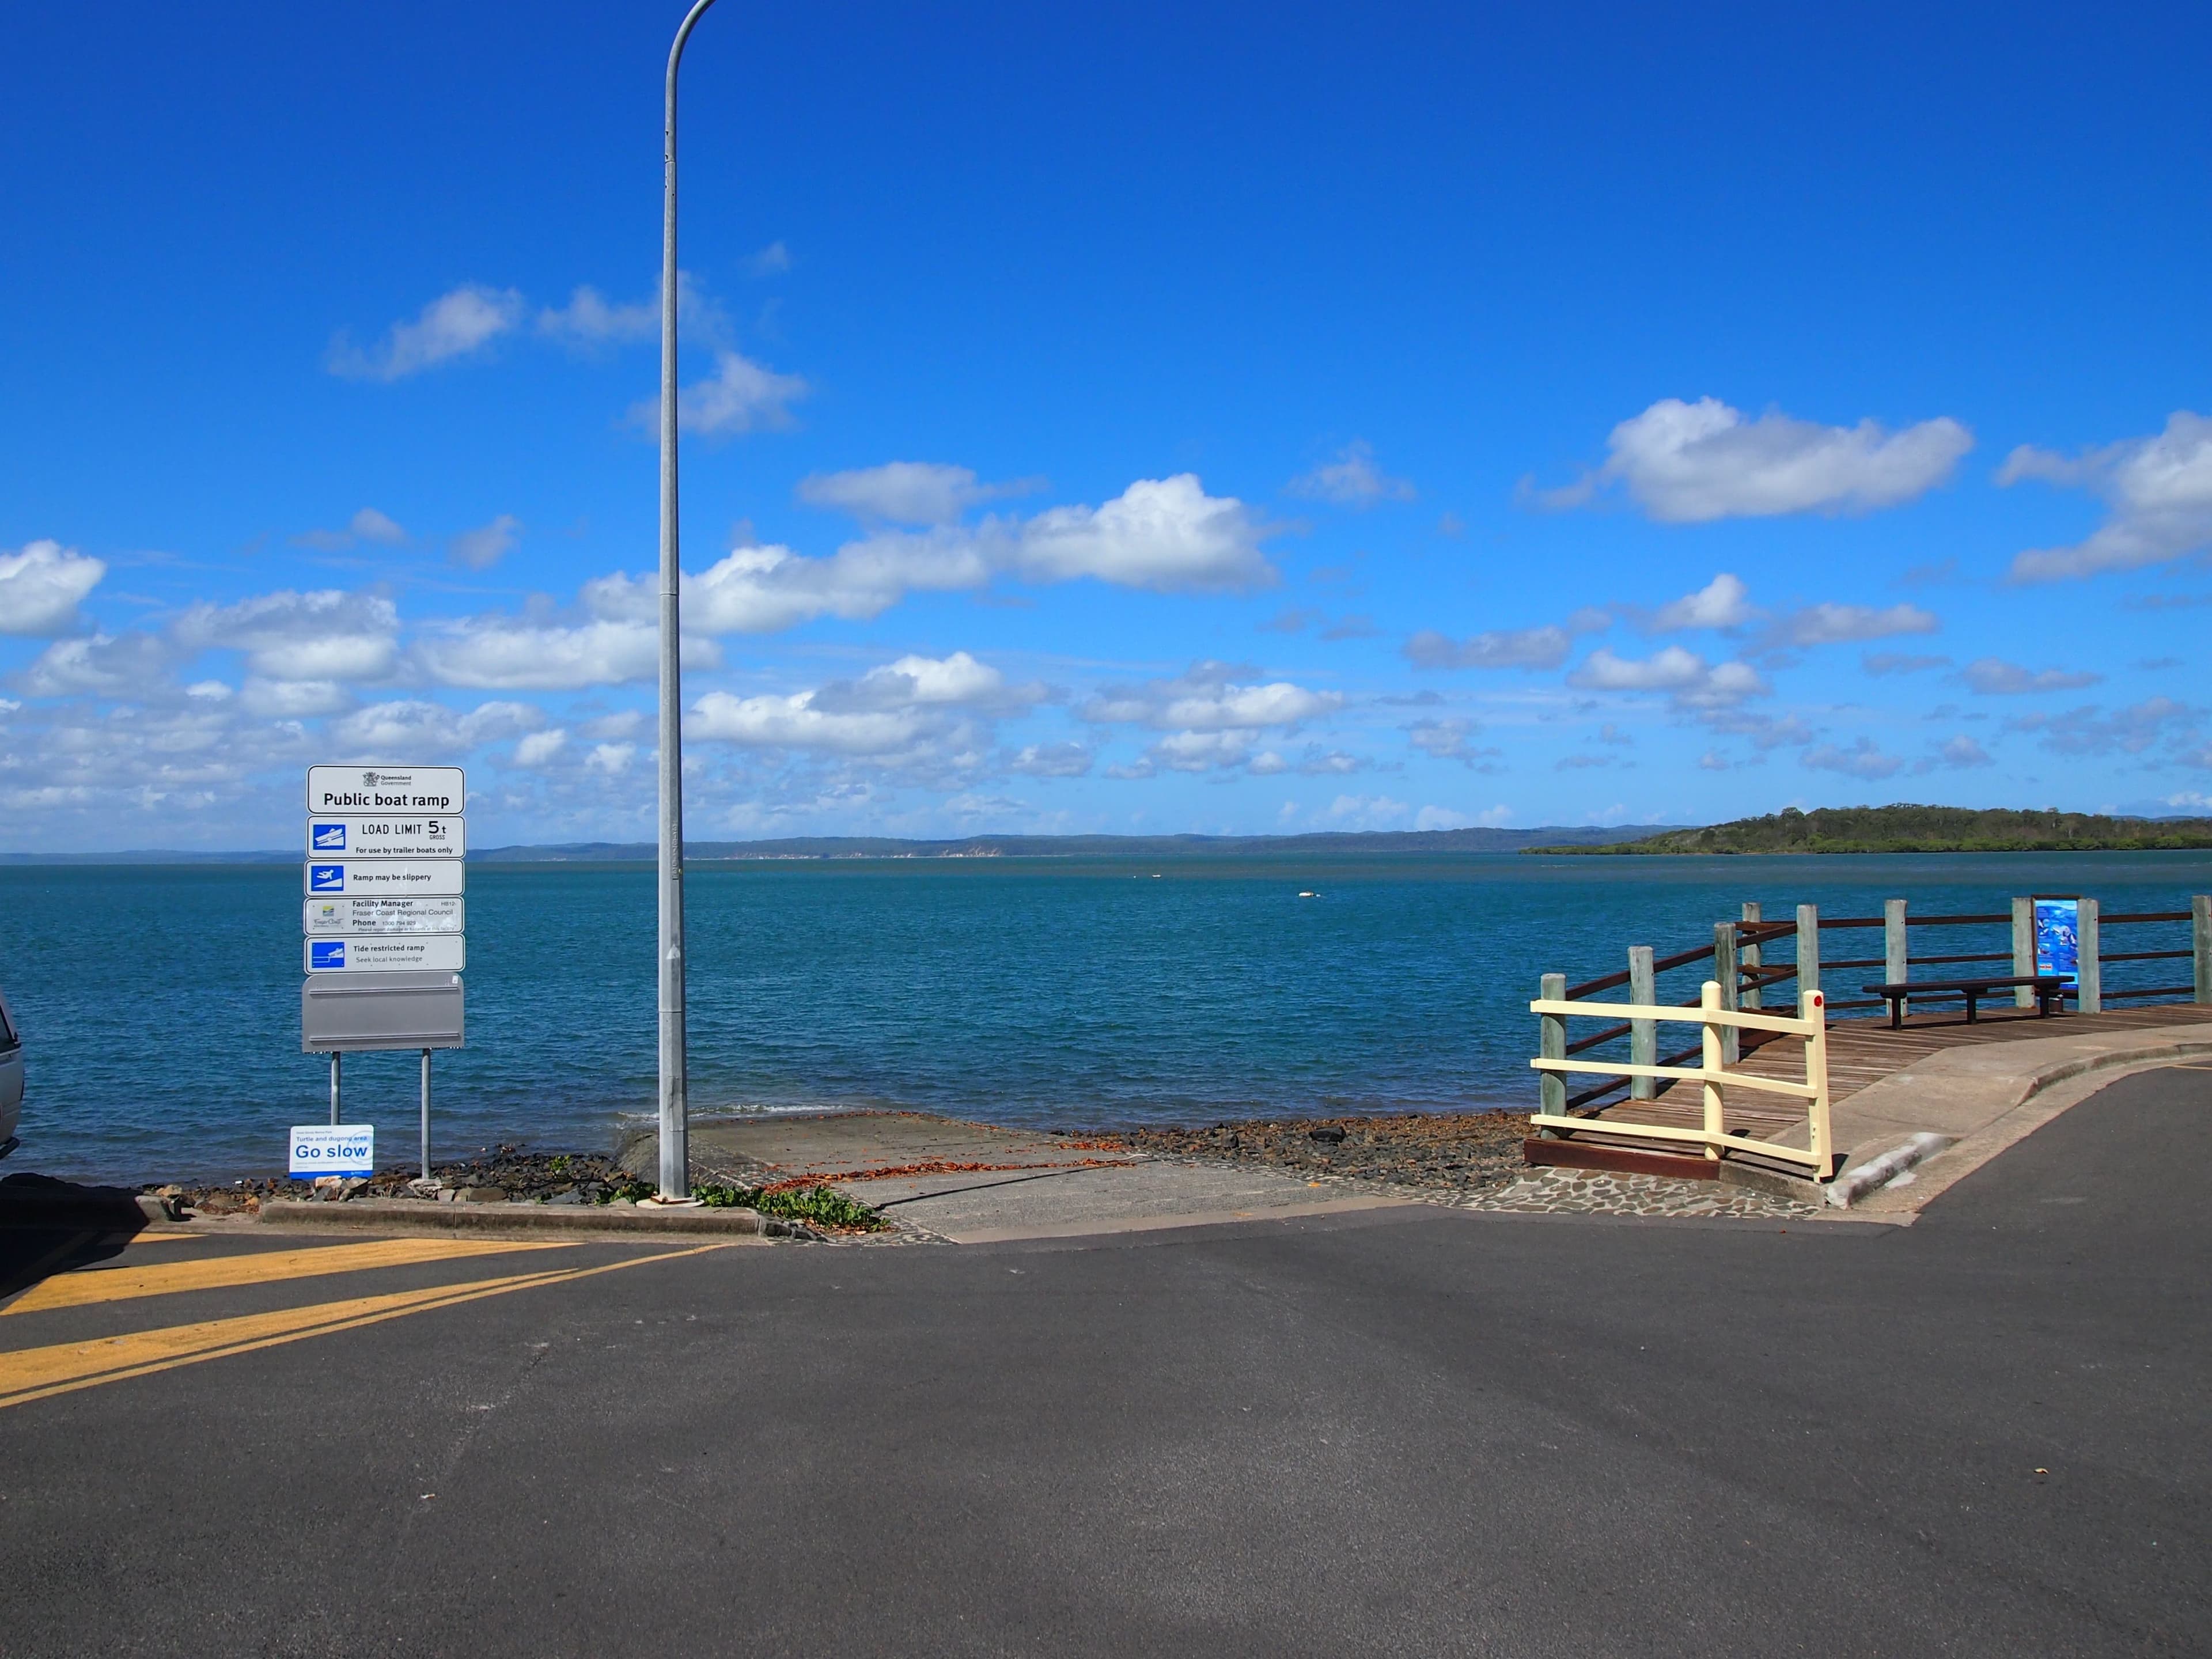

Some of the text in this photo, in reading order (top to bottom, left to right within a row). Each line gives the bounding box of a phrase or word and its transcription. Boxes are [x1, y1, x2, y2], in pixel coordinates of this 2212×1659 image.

[324, 793, 449, 809] Public boat ramp
[362, 824, 389, 834] LOAD
[396, 824, 422, 834] LIMIT
[296, 1144, 368, 1158] Go slow
